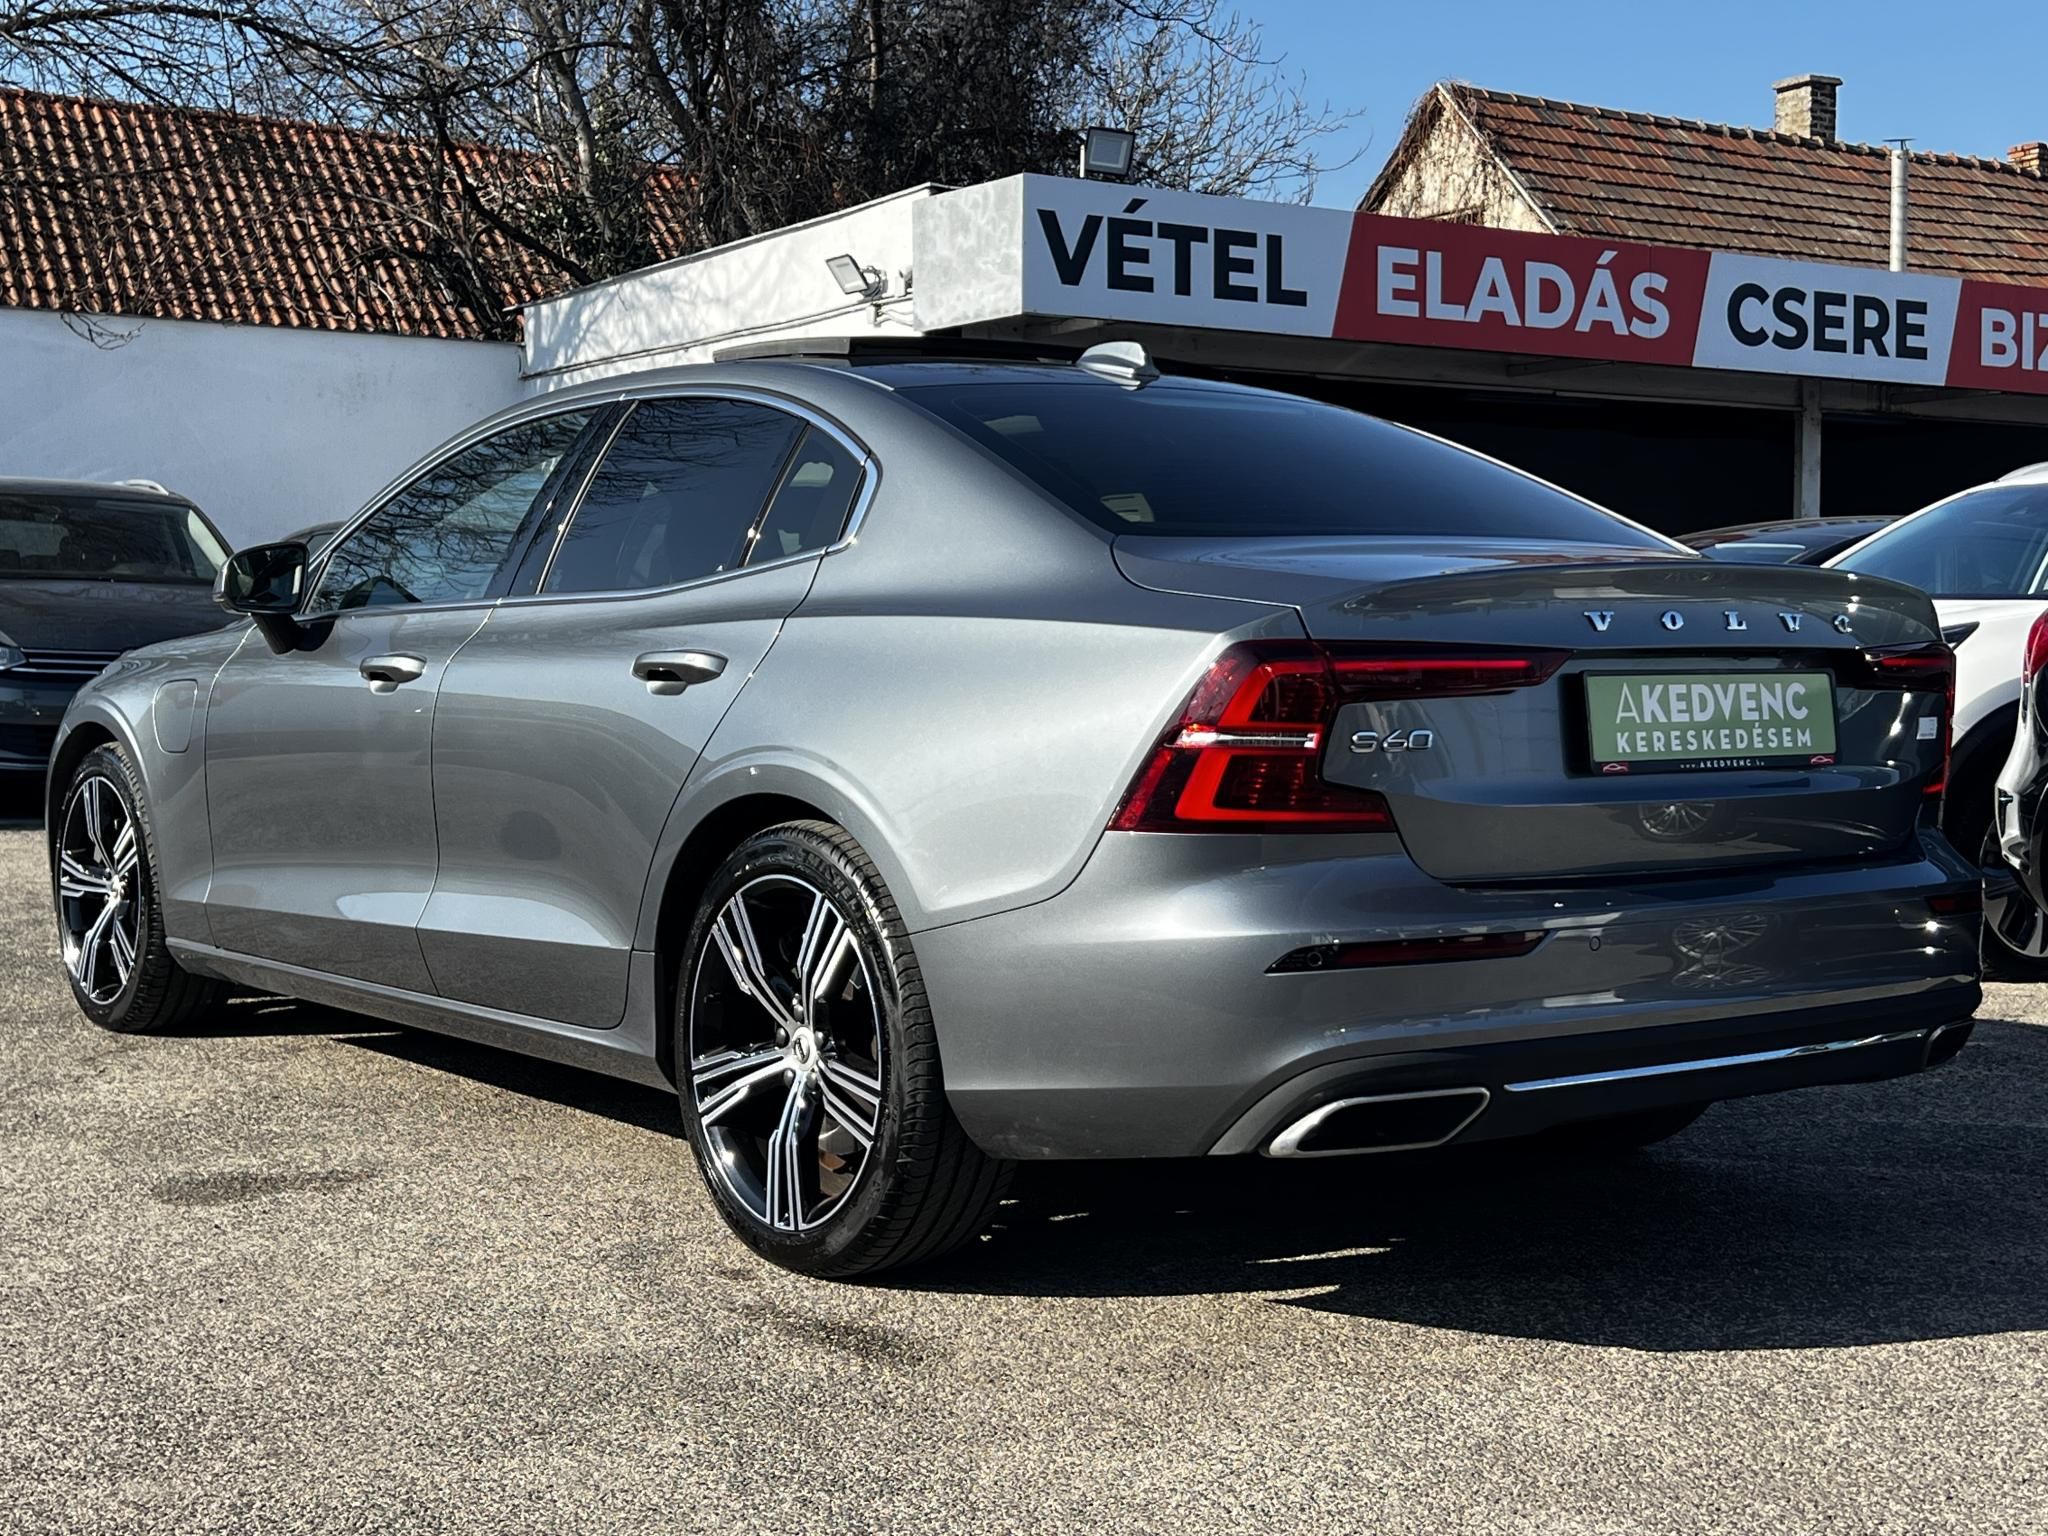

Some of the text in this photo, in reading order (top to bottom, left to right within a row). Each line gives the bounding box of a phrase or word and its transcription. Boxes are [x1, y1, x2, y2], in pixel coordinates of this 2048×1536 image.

[1036, 197, 1308, 307] VÉTEL
[1376, 244, 1671, 340] ELADÁS
[1726, 282, 1928, 361] CSERE
[1584, 610, 1853, 634] VOLVO
[1349, 729, 1433, 753] S60
[1616, 723, 1812, 753] KERESKEDÉSEM
